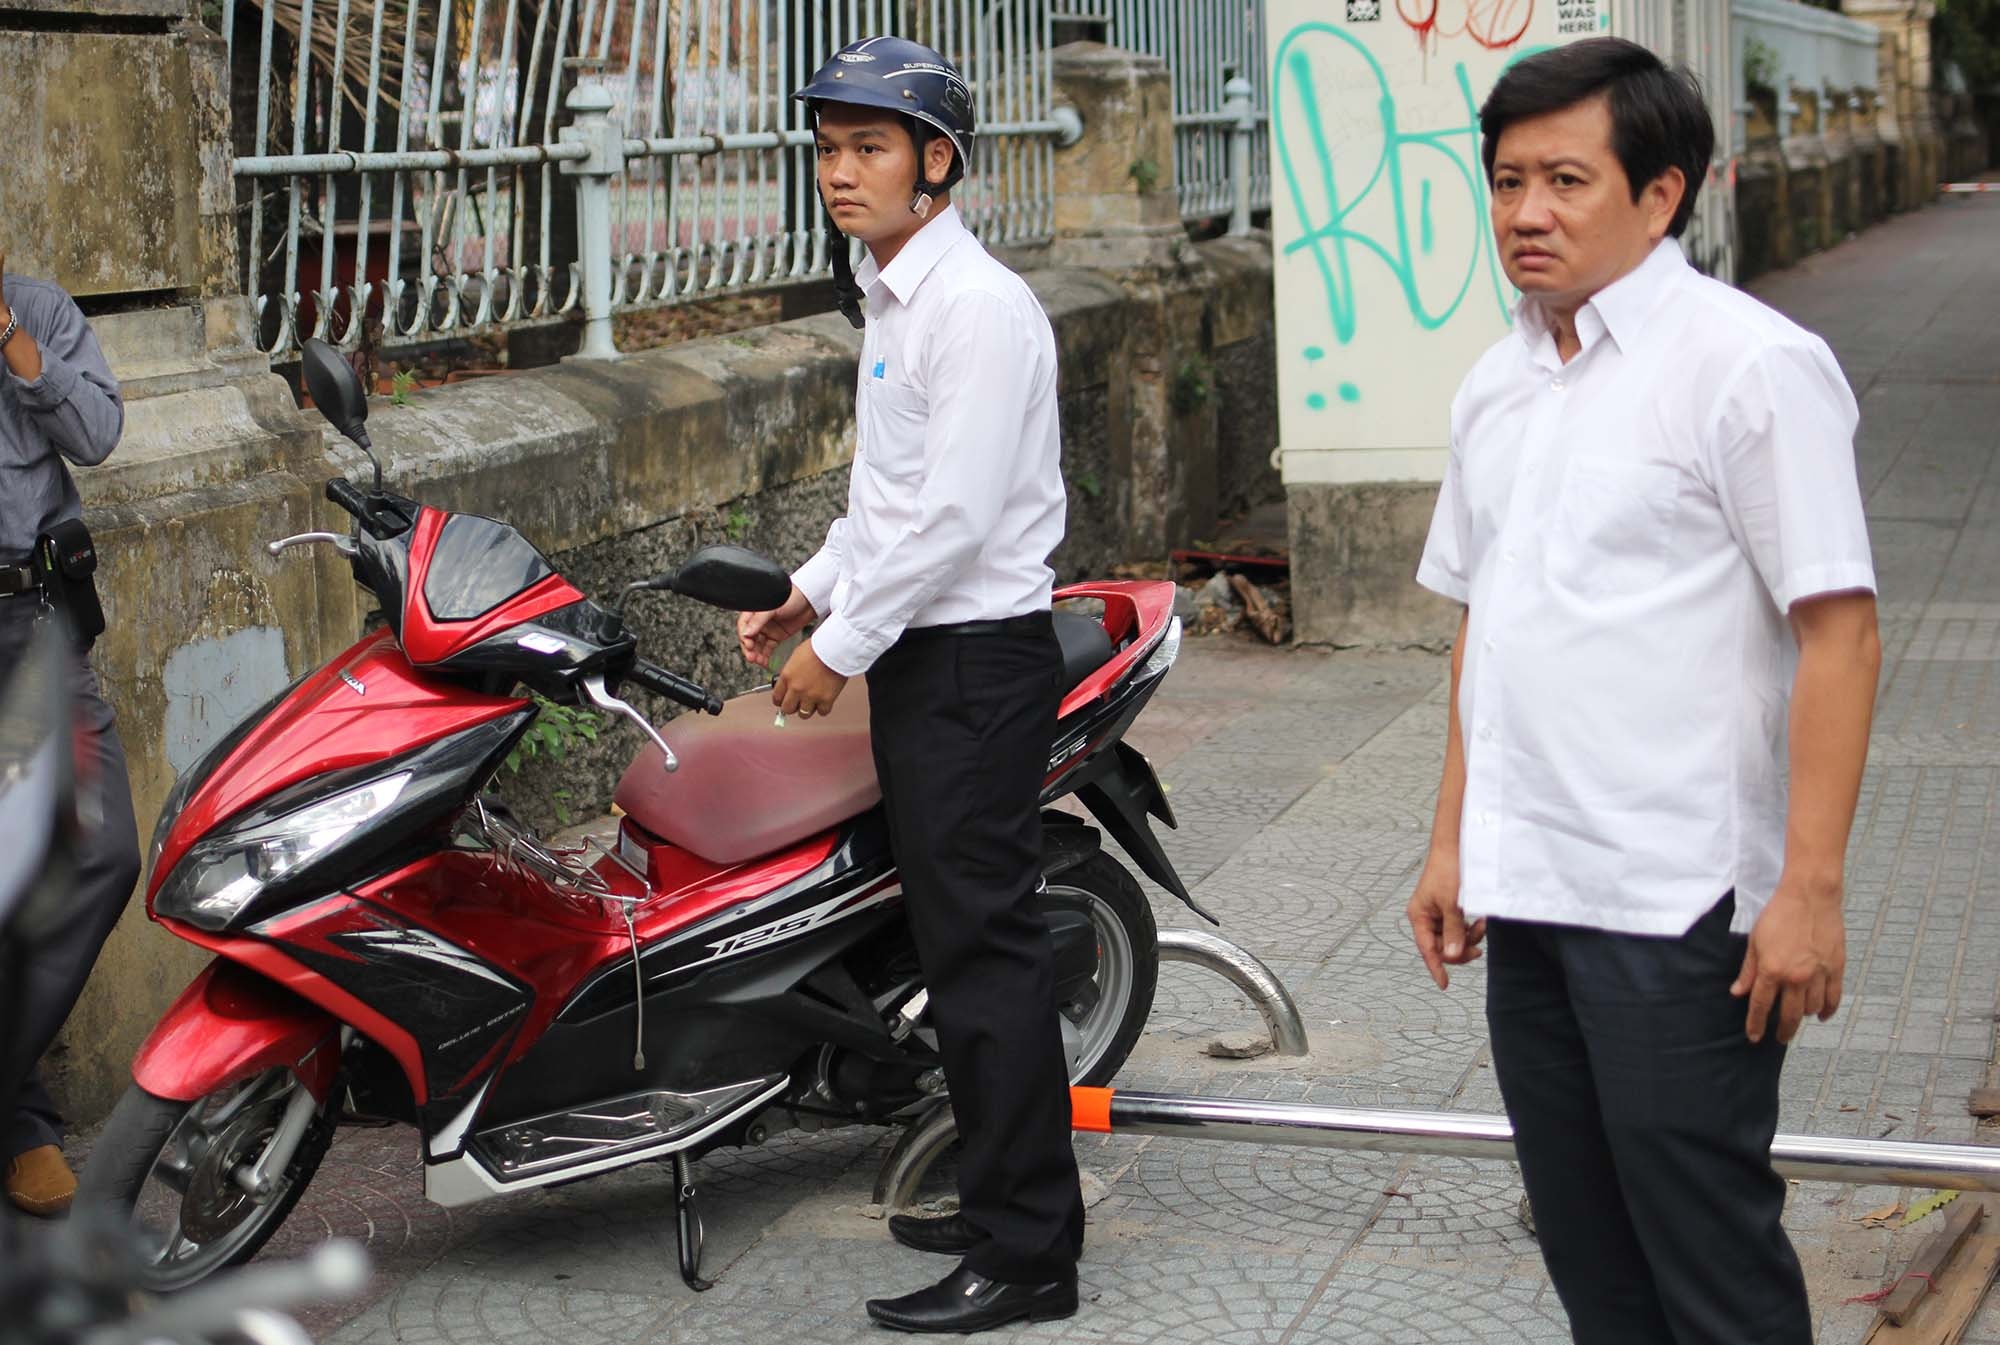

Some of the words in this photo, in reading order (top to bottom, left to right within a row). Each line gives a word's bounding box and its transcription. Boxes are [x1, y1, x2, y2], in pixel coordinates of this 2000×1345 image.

[1558, 7, 1596, 19] WAS
[1558, 21, 1594, 33] HERE
[712, 912, 817, 956] 125
